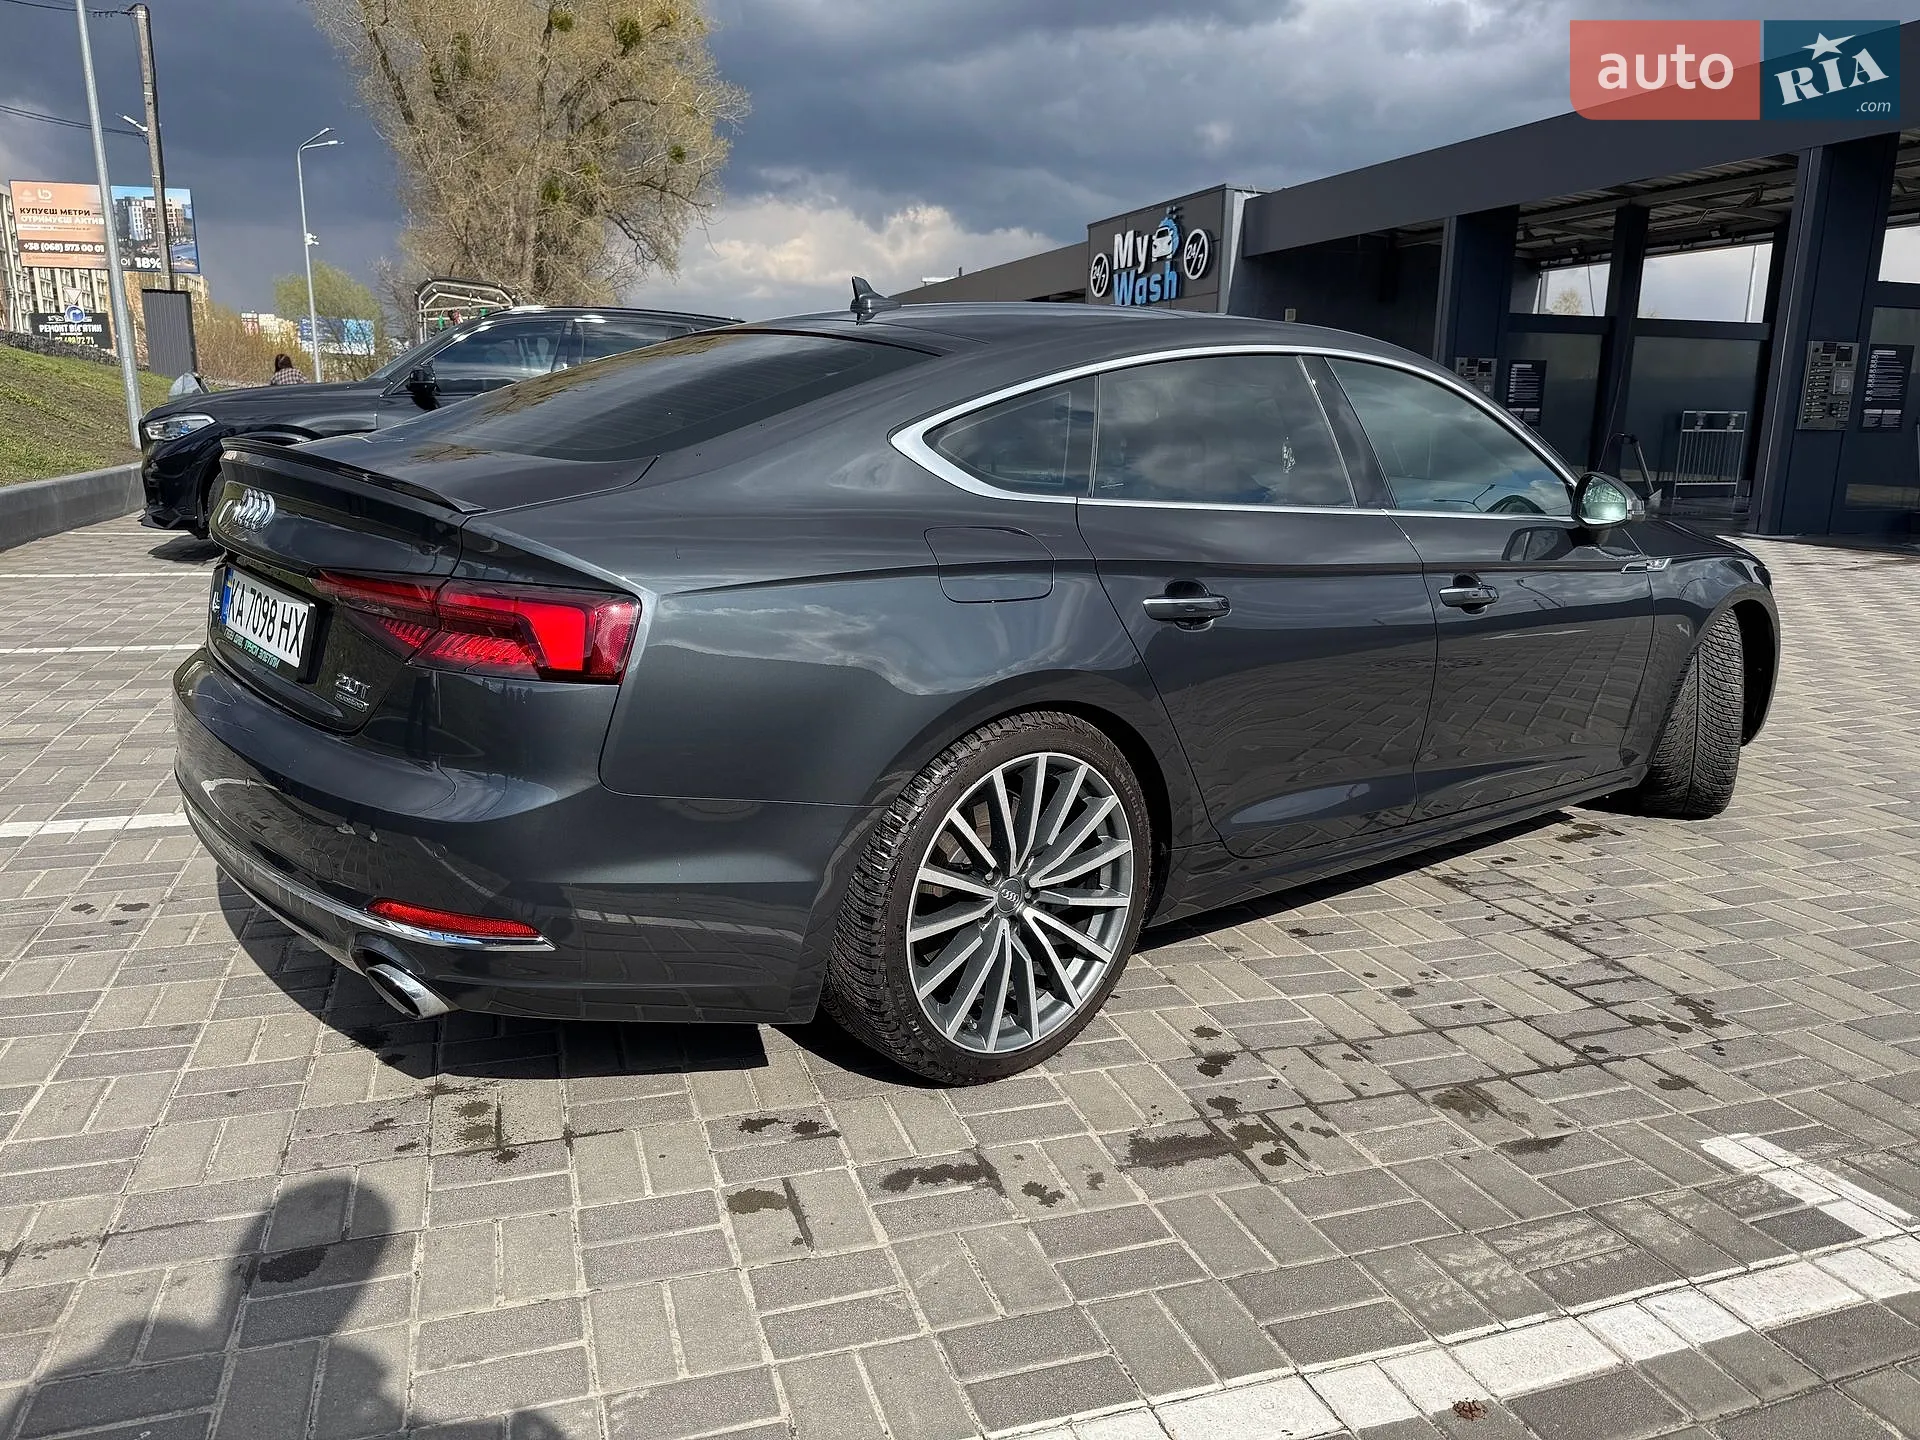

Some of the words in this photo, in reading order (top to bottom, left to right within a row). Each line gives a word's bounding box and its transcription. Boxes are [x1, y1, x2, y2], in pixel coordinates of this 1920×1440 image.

[19, 207, 58, 215] КУПУЄШ
[60, 208, 91, 216] МЕТРИ
[24, 242, 40, 251] +38
[81, 244, 94, 252] 00
[1113, 229, 1149, 274] My
[1185, 236, 1204, 276] 24/7
[135, 257, 161, 268] 18%
[1113, 261, 1178, 307] Wash
[39, 324, 69, 333] РЕМОНТ
[228, 578, 247, 628] KA
[245, 587, 278, 643] 7098
[277, 603, 307, 659] HX
